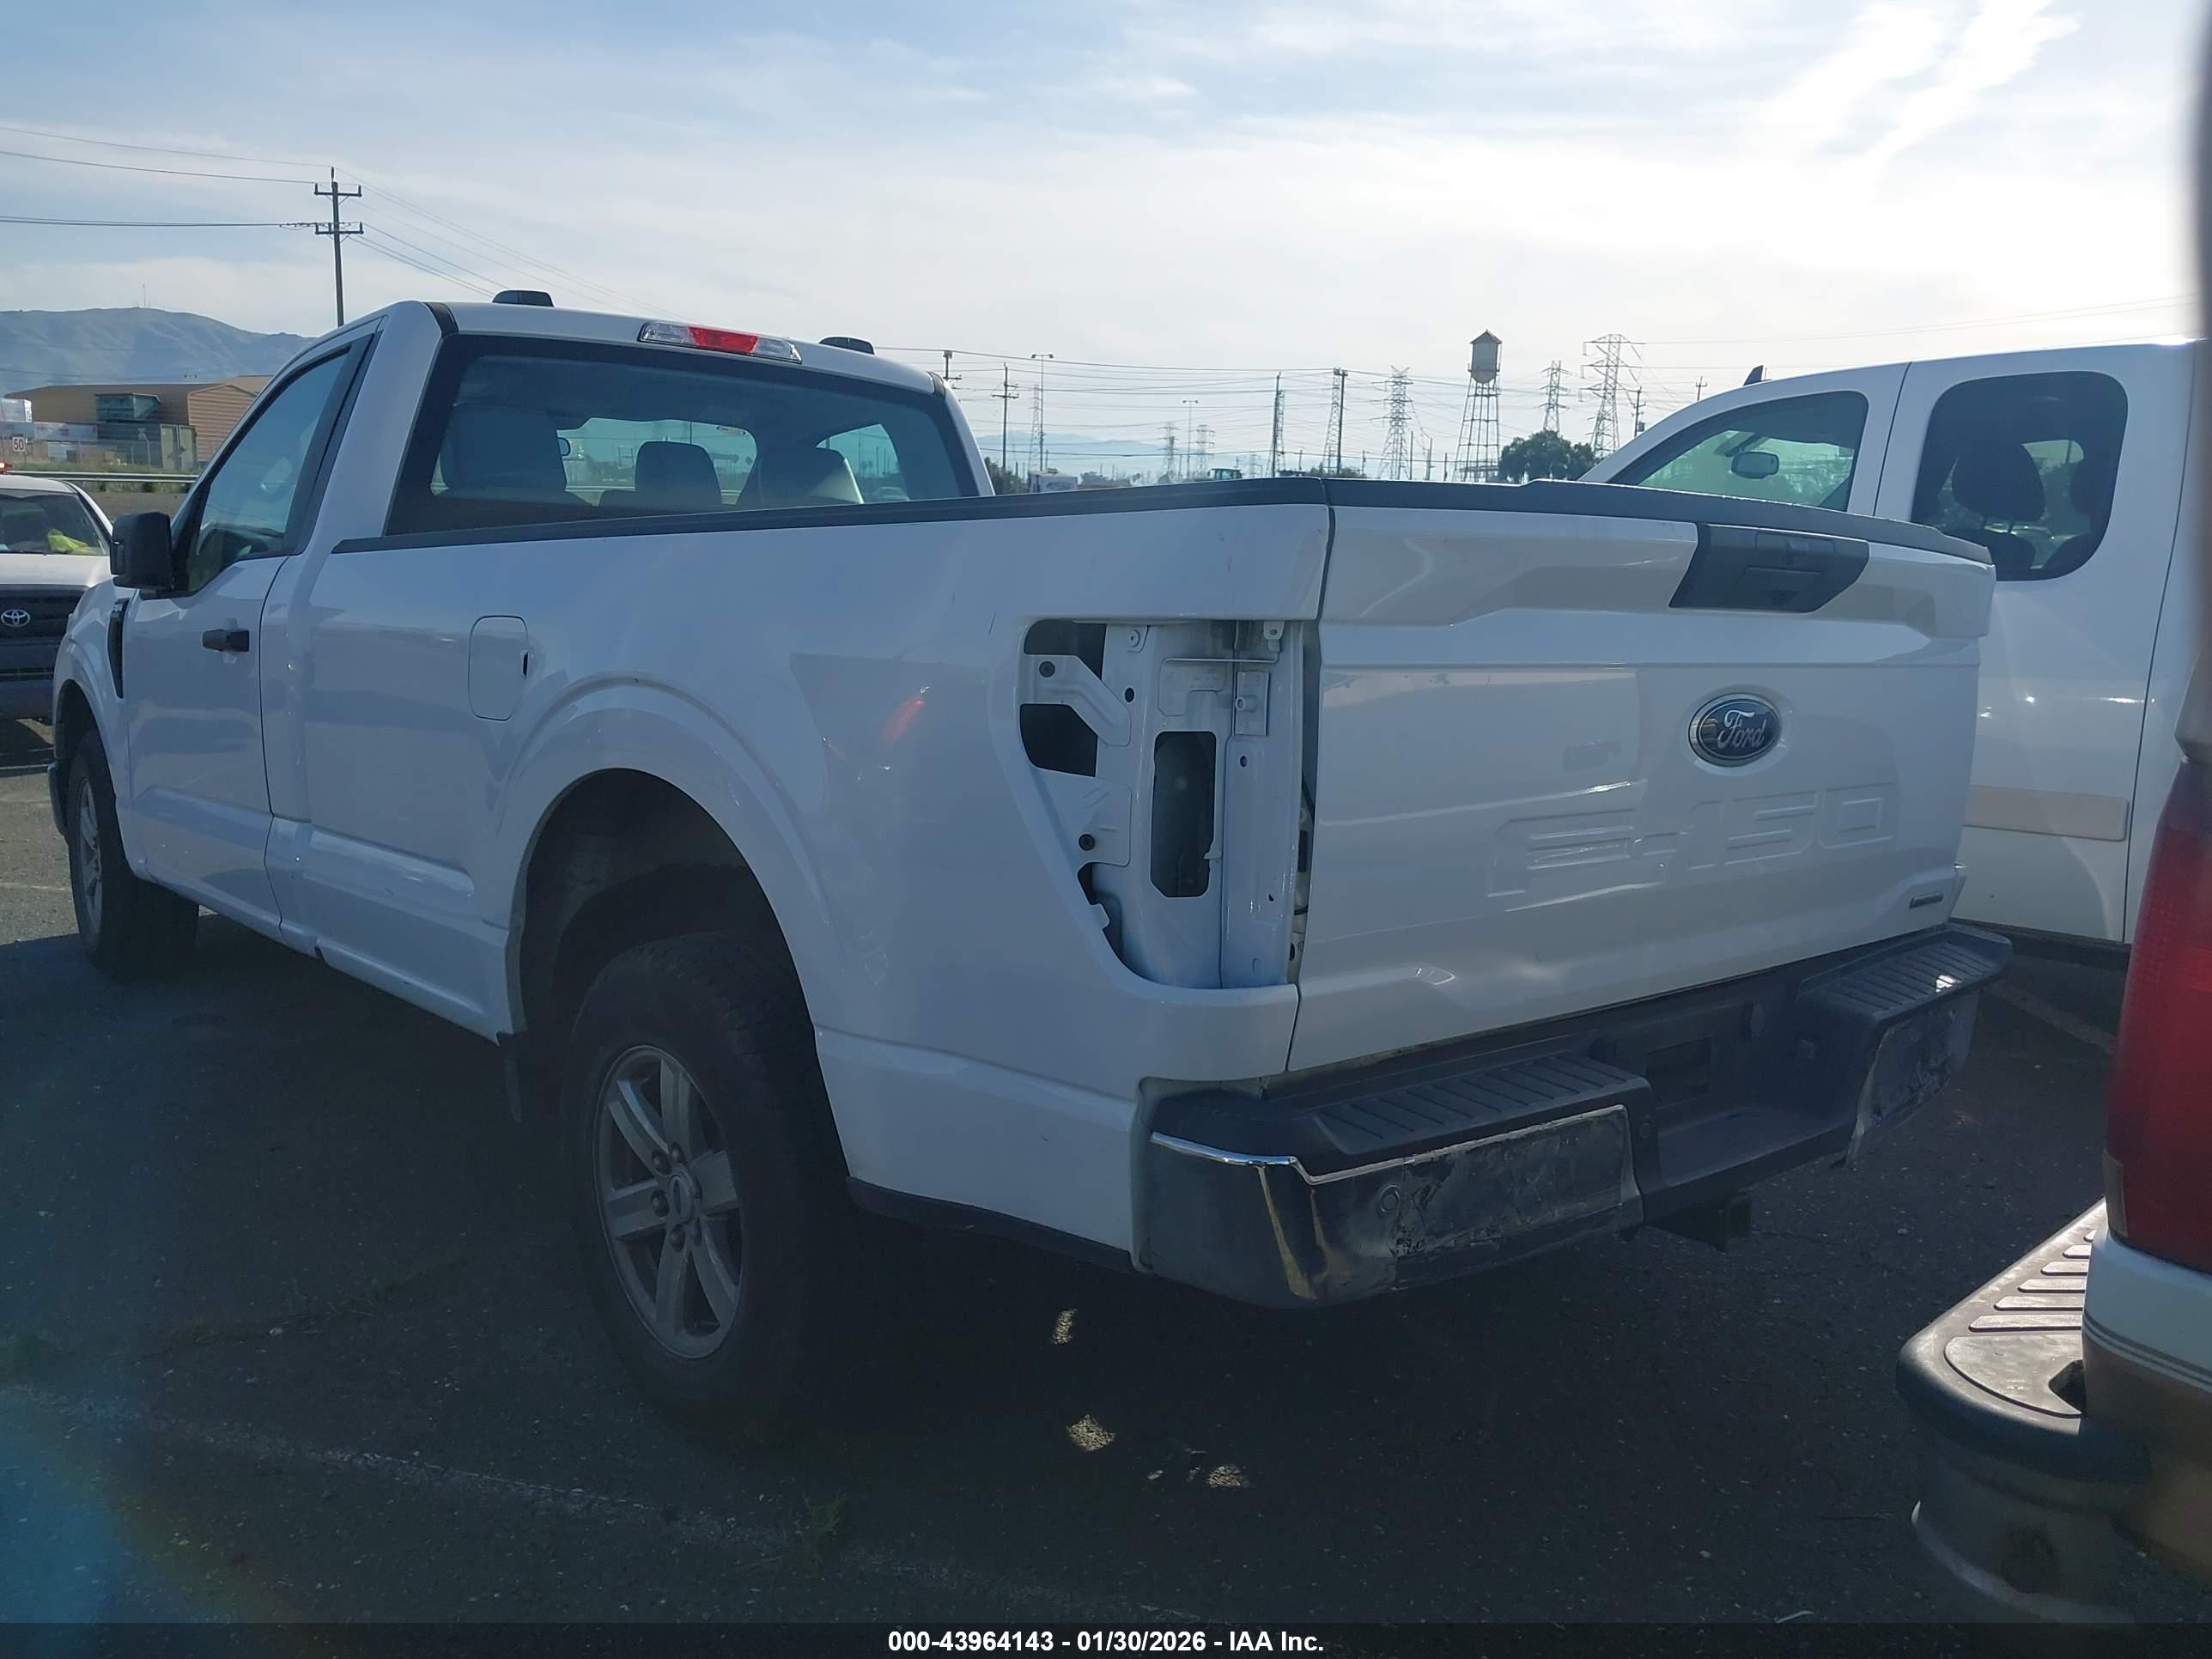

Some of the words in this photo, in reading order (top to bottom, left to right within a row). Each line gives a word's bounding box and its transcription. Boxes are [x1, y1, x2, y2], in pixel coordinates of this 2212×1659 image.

[13, 439, 24, 451] 50
[1717, 709, 1767, 749] Ford
[1486, 781, 1898, 898] F-150
